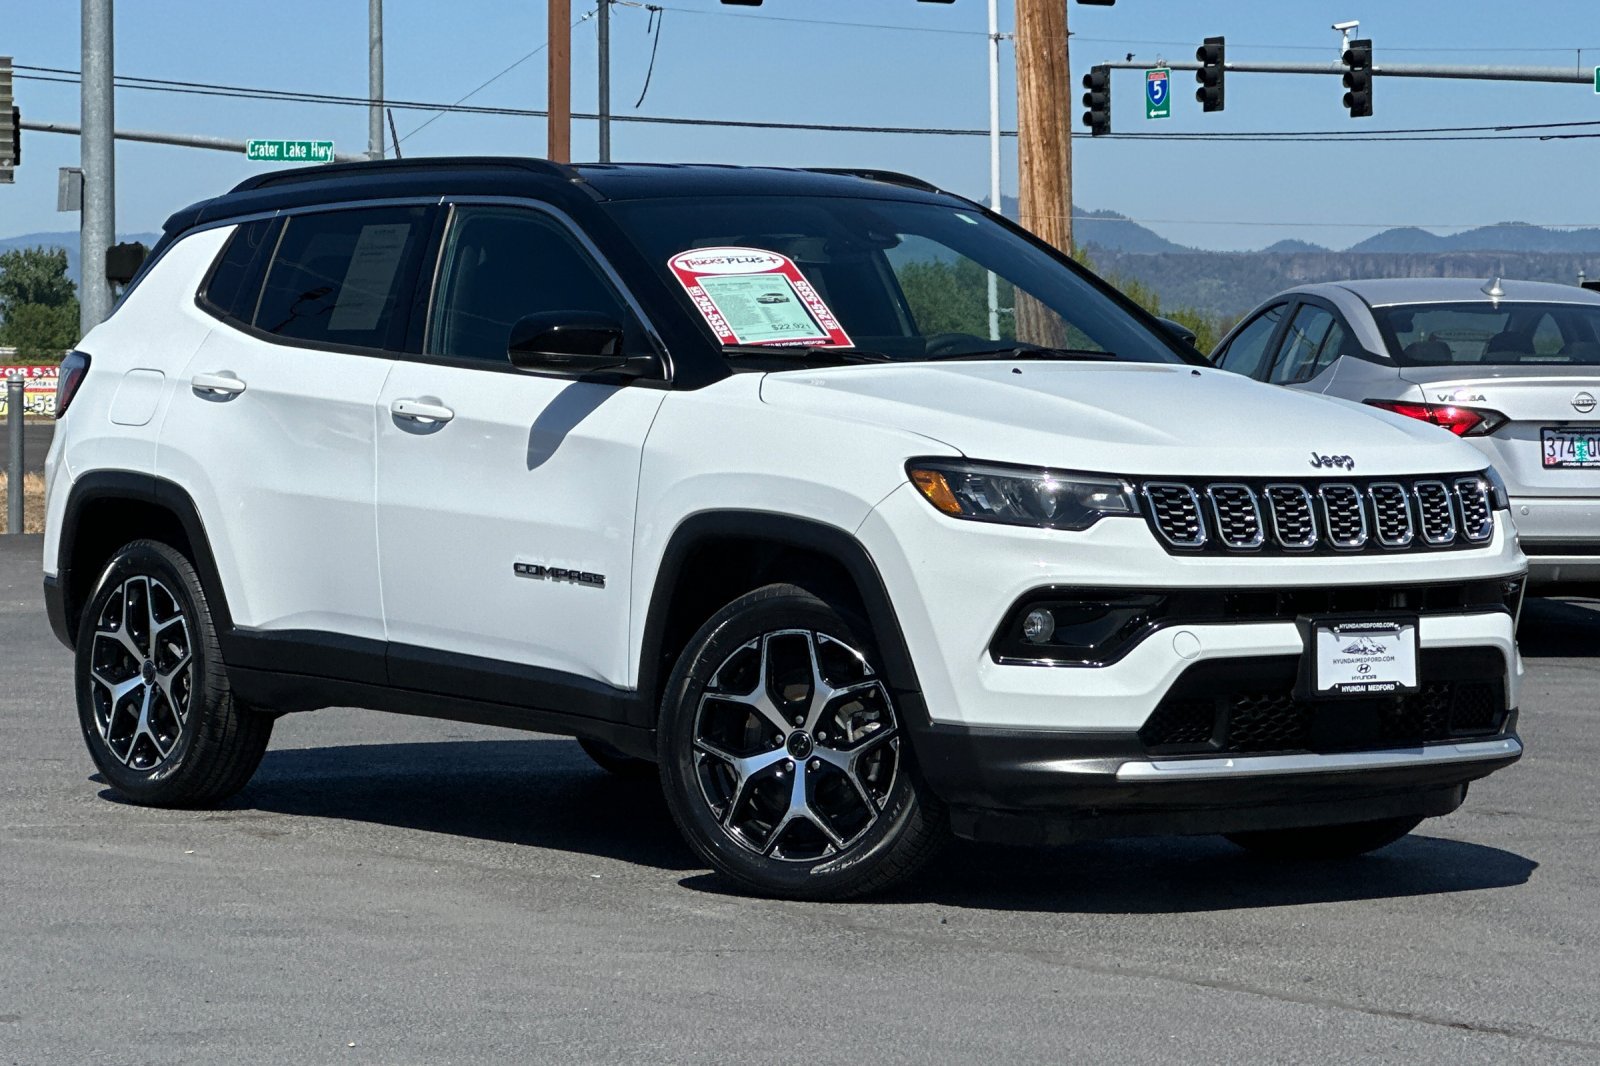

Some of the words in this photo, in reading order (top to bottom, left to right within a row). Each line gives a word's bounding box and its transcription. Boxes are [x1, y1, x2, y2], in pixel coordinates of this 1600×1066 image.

[1153, 80, 1162, 99] 5
[248, 141, 279, 157] Crater
[283, 142, 307, 158] Lake
[311, 142, 333, 163] Hwy
[1546, 436, 1576, 458] 374
[1310, 451, 1355, 471] Jeep
[513, 562, 606, 585] COMPASS
[1332, 656, 1395, 664] HYUNDAIMEDFORD.COM
[1367, 684, 1395, 692] MEDFORD
